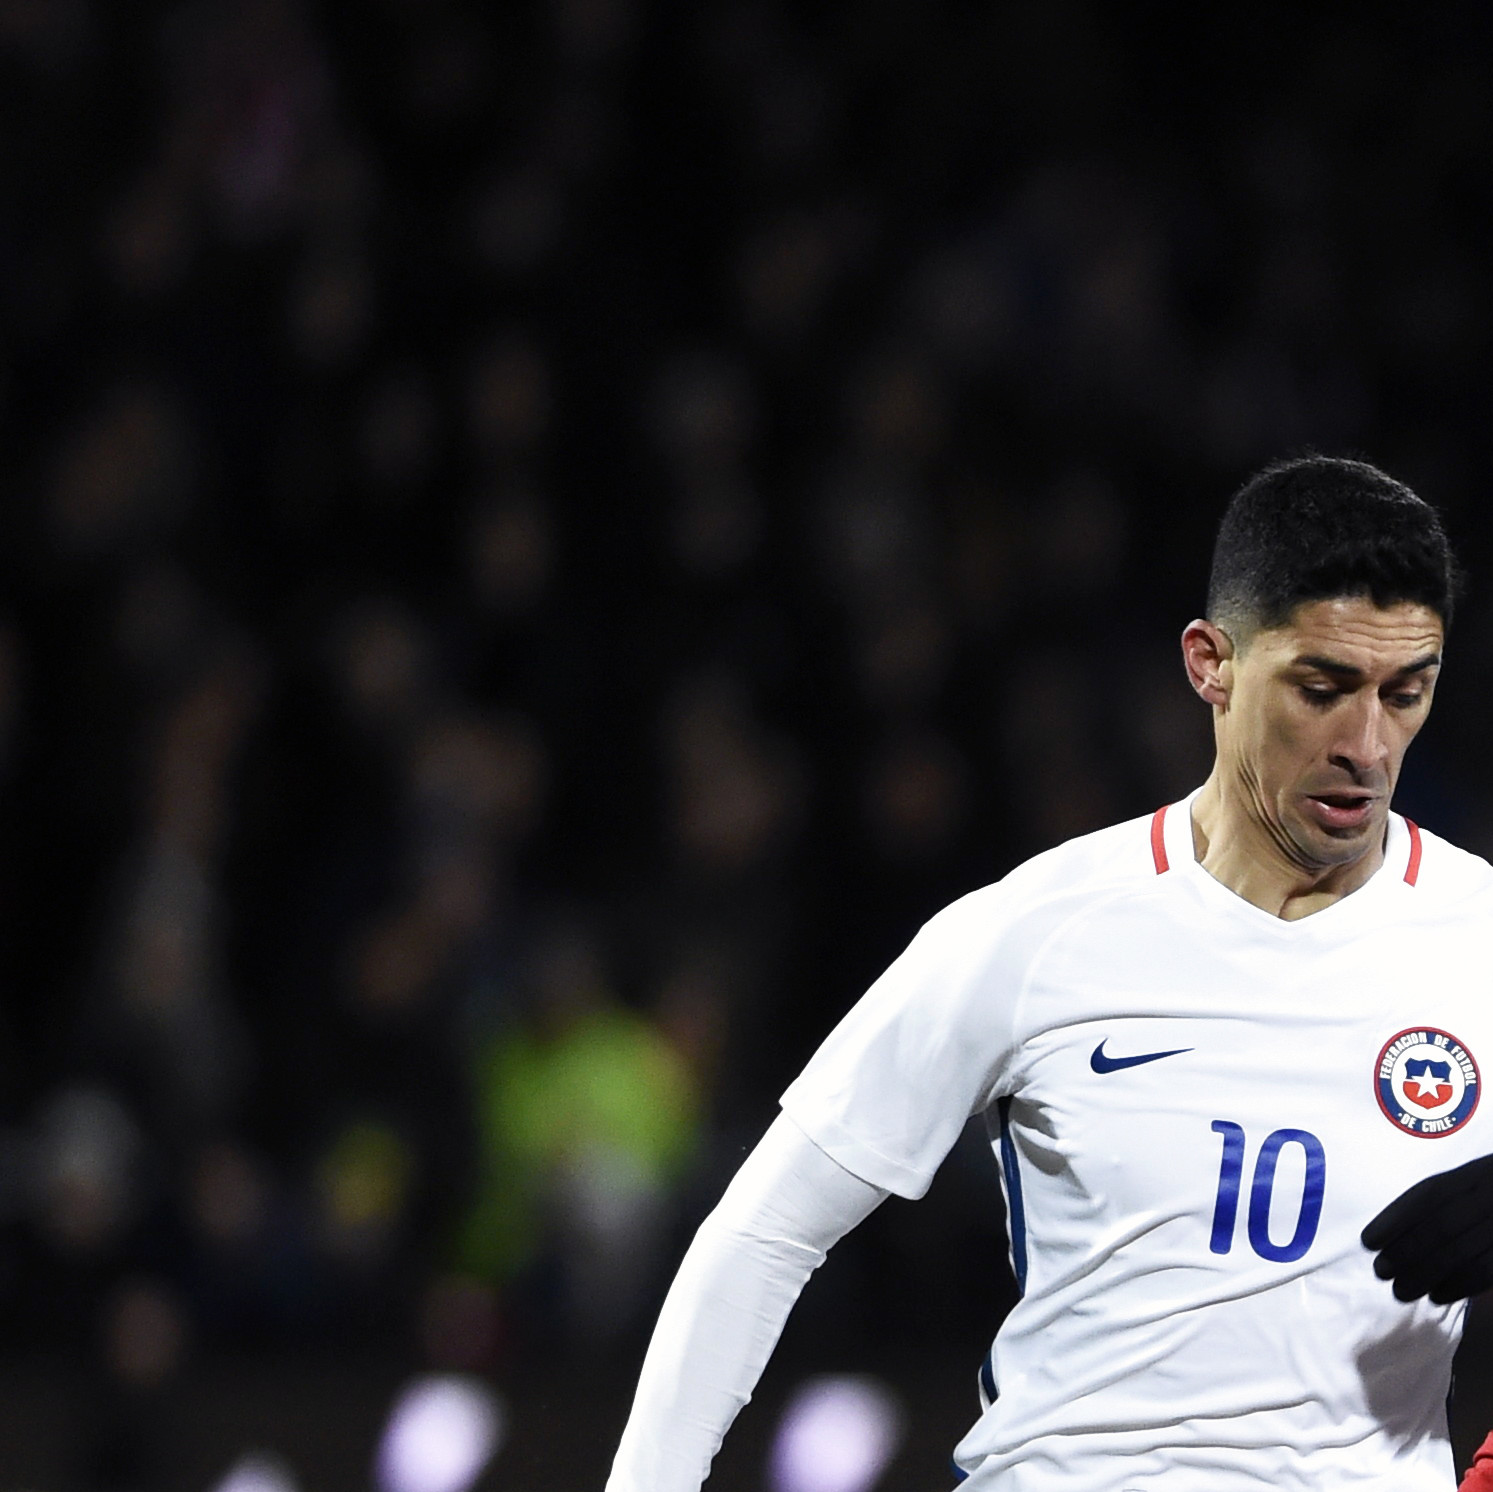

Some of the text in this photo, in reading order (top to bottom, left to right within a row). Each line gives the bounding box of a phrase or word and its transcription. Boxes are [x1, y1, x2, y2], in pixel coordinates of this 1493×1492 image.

[1434, 1033, 1450, 1049] DE
[1450, 1045, 1477, 1087] FUTBOL
[1400, 1113, 1454, 1133] DE CHILE
[1209, 1120, 1326, 1264] 10
